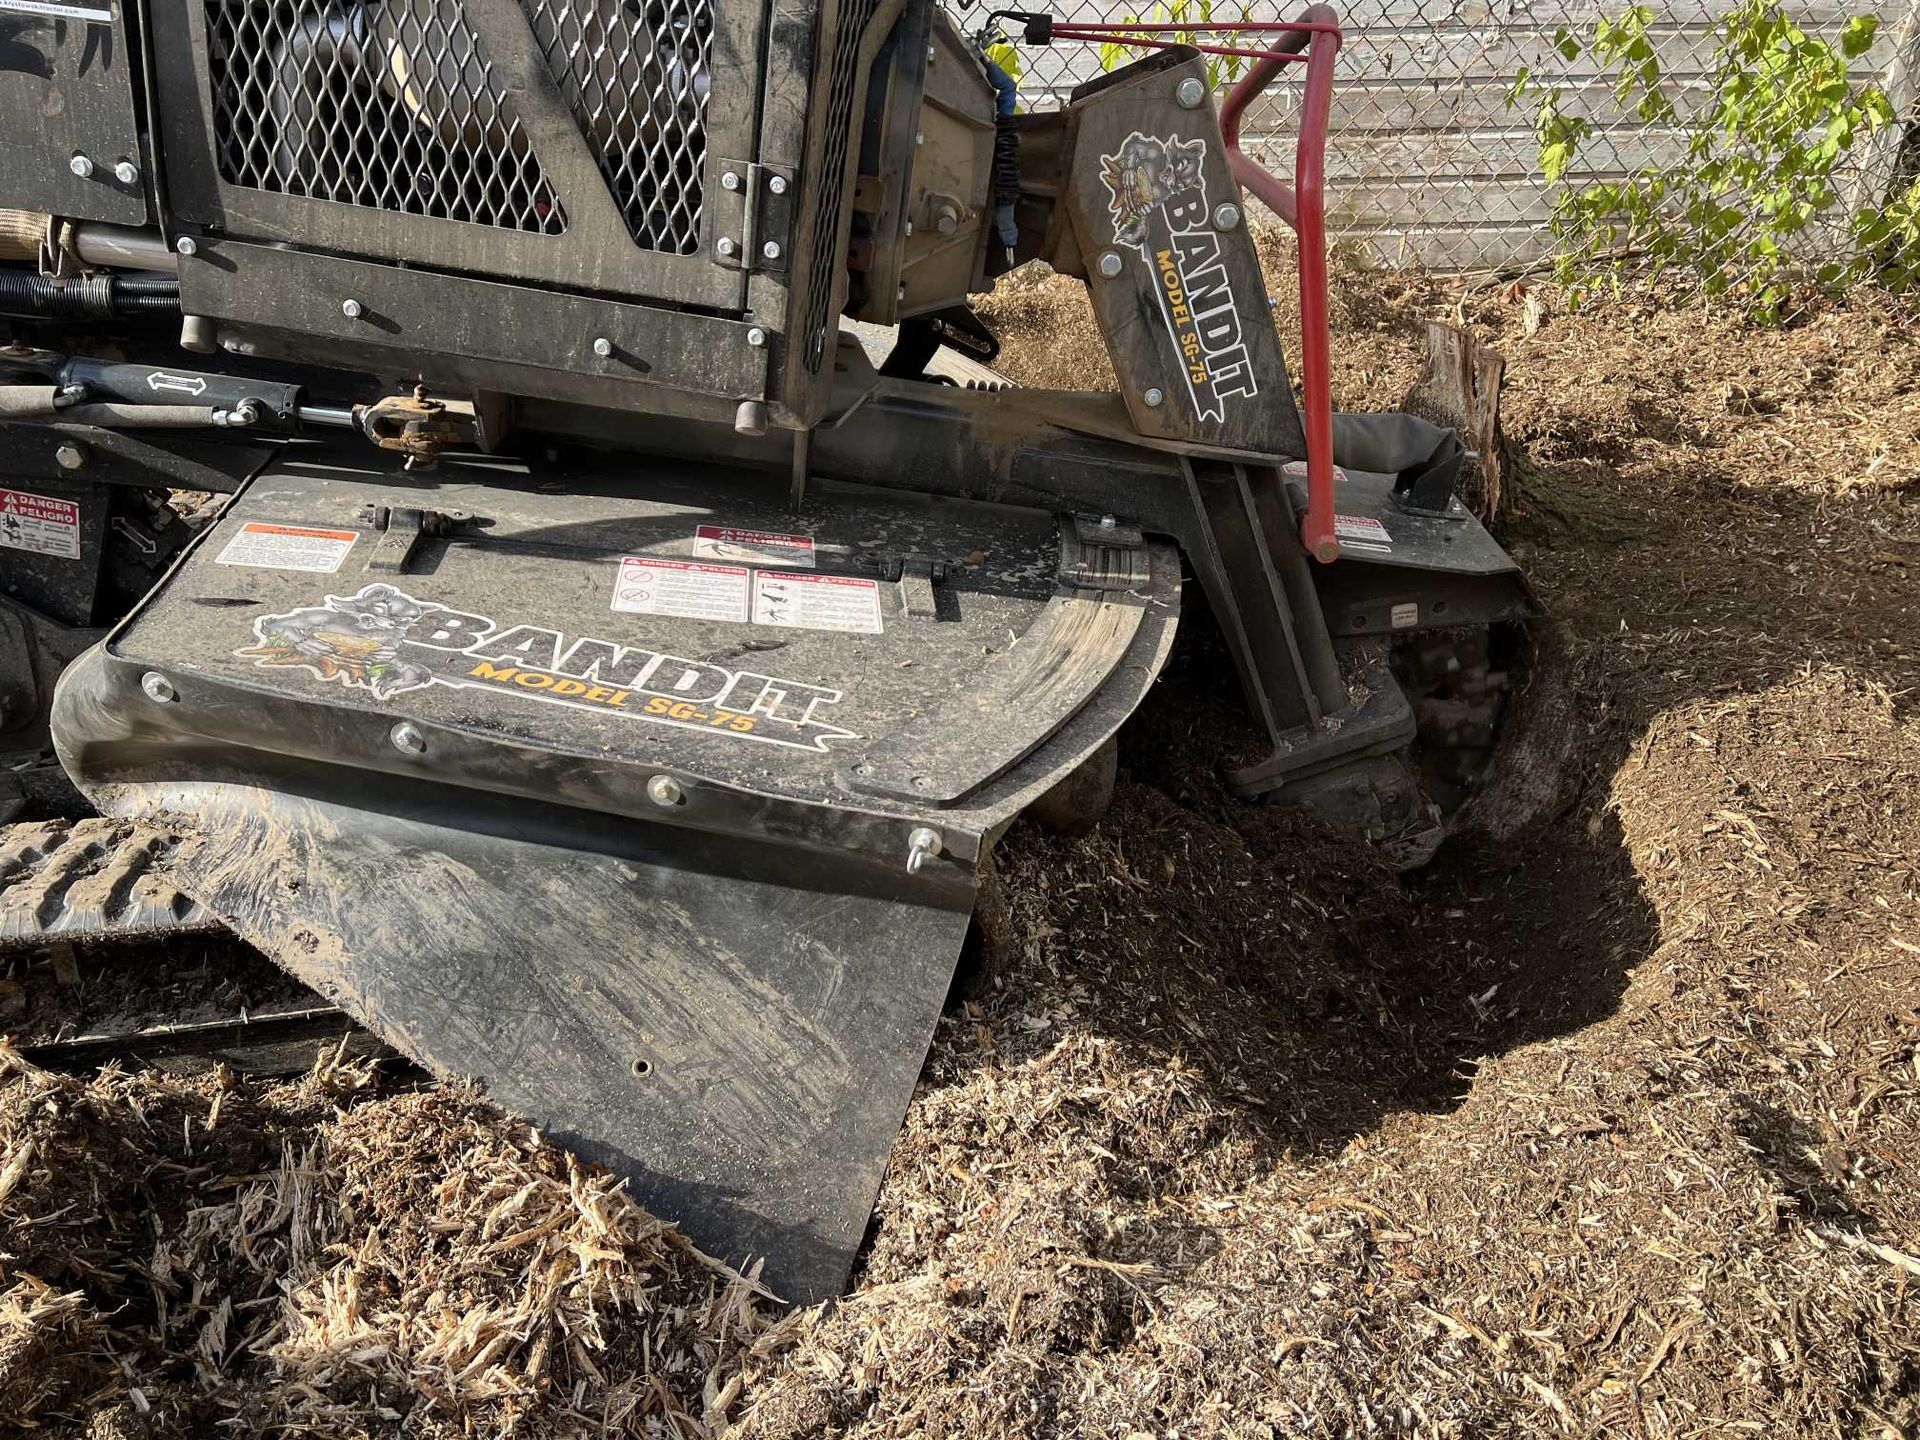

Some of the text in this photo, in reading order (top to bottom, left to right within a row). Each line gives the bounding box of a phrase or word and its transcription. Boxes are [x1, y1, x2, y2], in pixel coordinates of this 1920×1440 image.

[1156, 249, 1208, 384] MODEL SG-75
[1162, 186, 1258, 398] BANDIT
[19, 495, 71, 512] DANGER
[19, 506, 74, 523] PELIGRO
[402, 606, 843, 726] BANDIT
[469, 661, 758, 732] MODEL SG-75
